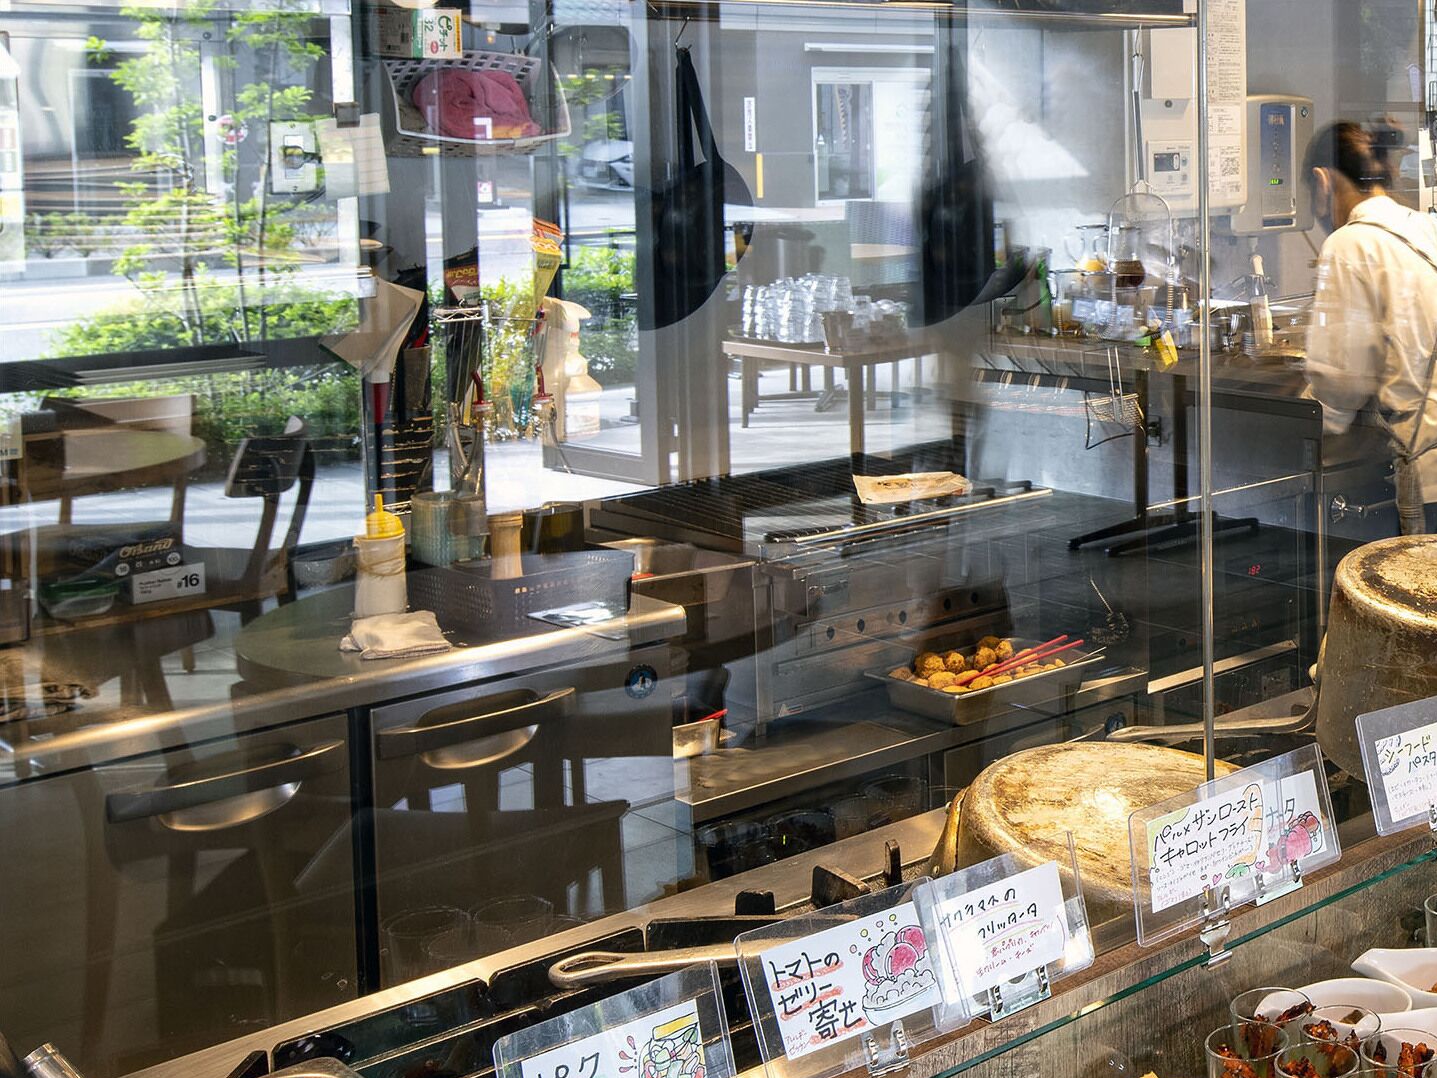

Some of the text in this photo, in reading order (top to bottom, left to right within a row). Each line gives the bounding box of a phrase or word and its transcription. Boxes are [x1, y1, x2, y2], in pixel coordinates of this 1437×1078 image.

[1385, 734, 1432, 765] シーフード
[1154, 792, 1259, 851] パルメザンロースト
[1160, 816, 1250, 867] キャロットフライ
[977, 902, 1039, 940] フリッタータ
[769, 951, 840, 988] トマトの
[777, 982, 833, 1015] ゼリー
[809, 999, 864, 1040] 寄せ
